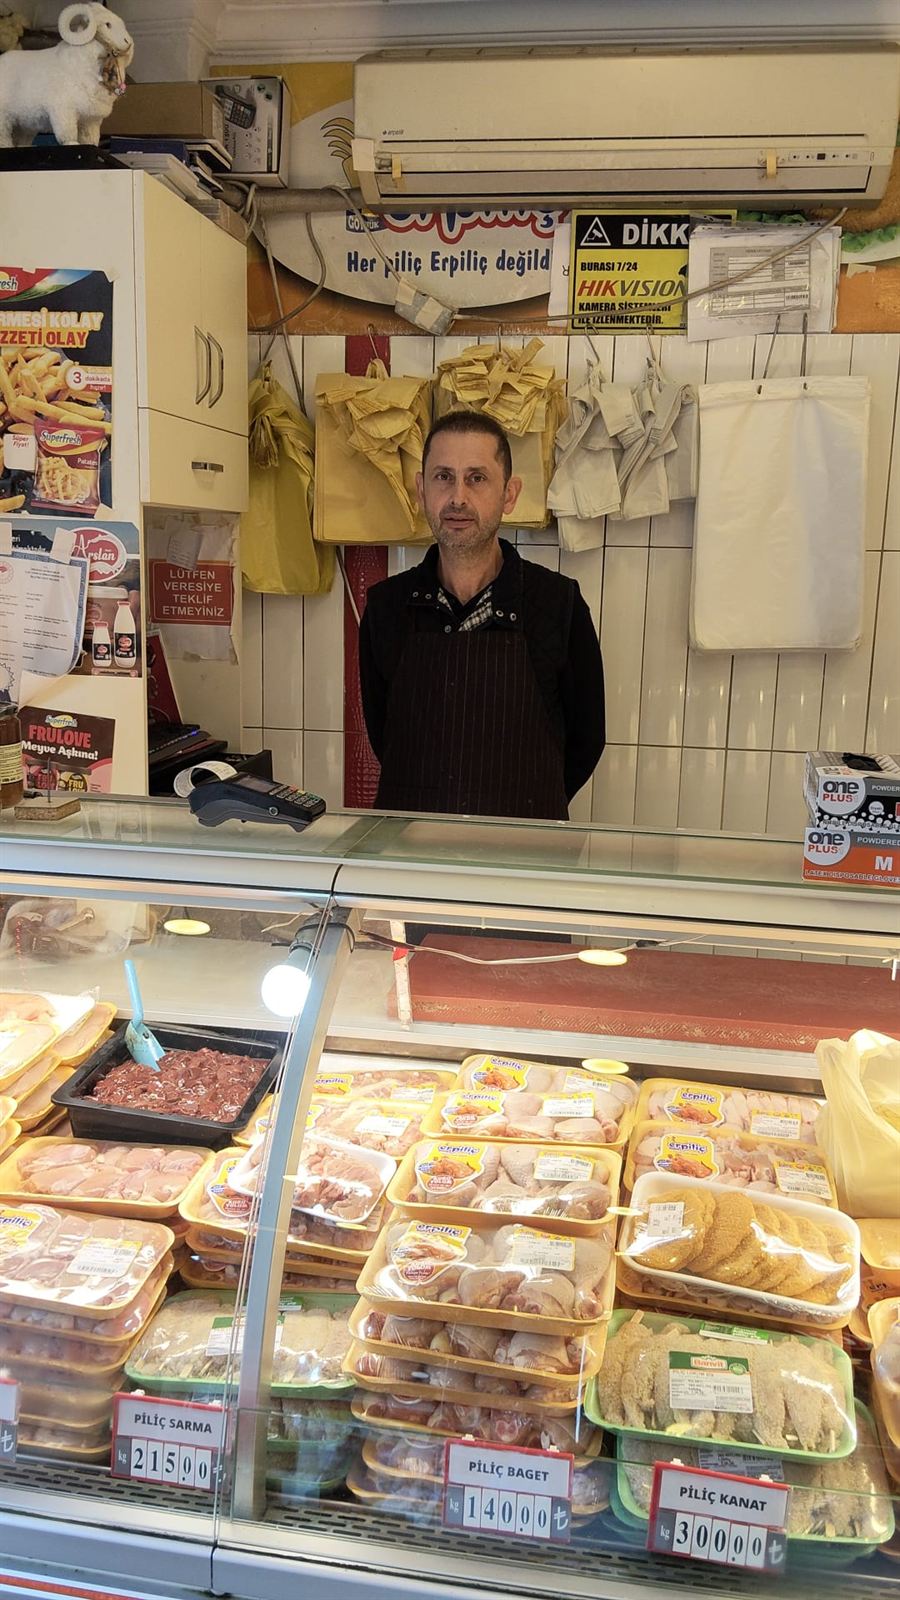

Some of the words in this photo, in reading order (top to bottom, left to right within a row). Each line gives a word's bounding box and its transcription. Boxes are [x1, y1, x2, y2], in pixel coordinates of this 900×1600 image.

[622, 218, 690, 245] DİKK
[347, 251, 376, 272] Her
[384, 250, 422, 279] piliç
[430, 249, 487, 278] Erpiliç
[581, 262, 614, 272] BURASI
[617, 262, 638, 272] 7/24
[577, 280, 687, 297] HIKVISION
[578, 302, 616, 312] KAMERA
[50, 312, 103, 330] KOLAY
[46, 331, 87, 346] OLAY
[73, 371, 82, 384] 3
[169, 569, 216, 580] LÜTFEN
[163, 581, 222, 593] VERESİYE
[173, 593, 213, 604] TEKLİF
[162, 605, 225, 617] ETMEYİNİZ
[28, 725, 92, 749] FRULOVE
[21, 740, 57, 755] Meyve
[822, 780, 860, 794] one
[822, 793, 853, 803] PLUS
[808, 831, 845, 846] one
[807, 844, 839, 854] PLUS
[874, 856, 893, 871] M
[134, 1412, 166, 1430] PİLİÇ
[169, 1418, 212, 1434] SARMA
[469, 1459, 504, 1479] PİLİÇ
[507, 1466, 549, 1482] BAGET
[679, 1484, 717, 1505] PİLİÇ
[719, 1493, 768, 1512] KANAT
[660, 1525, 670, 1541] kg
